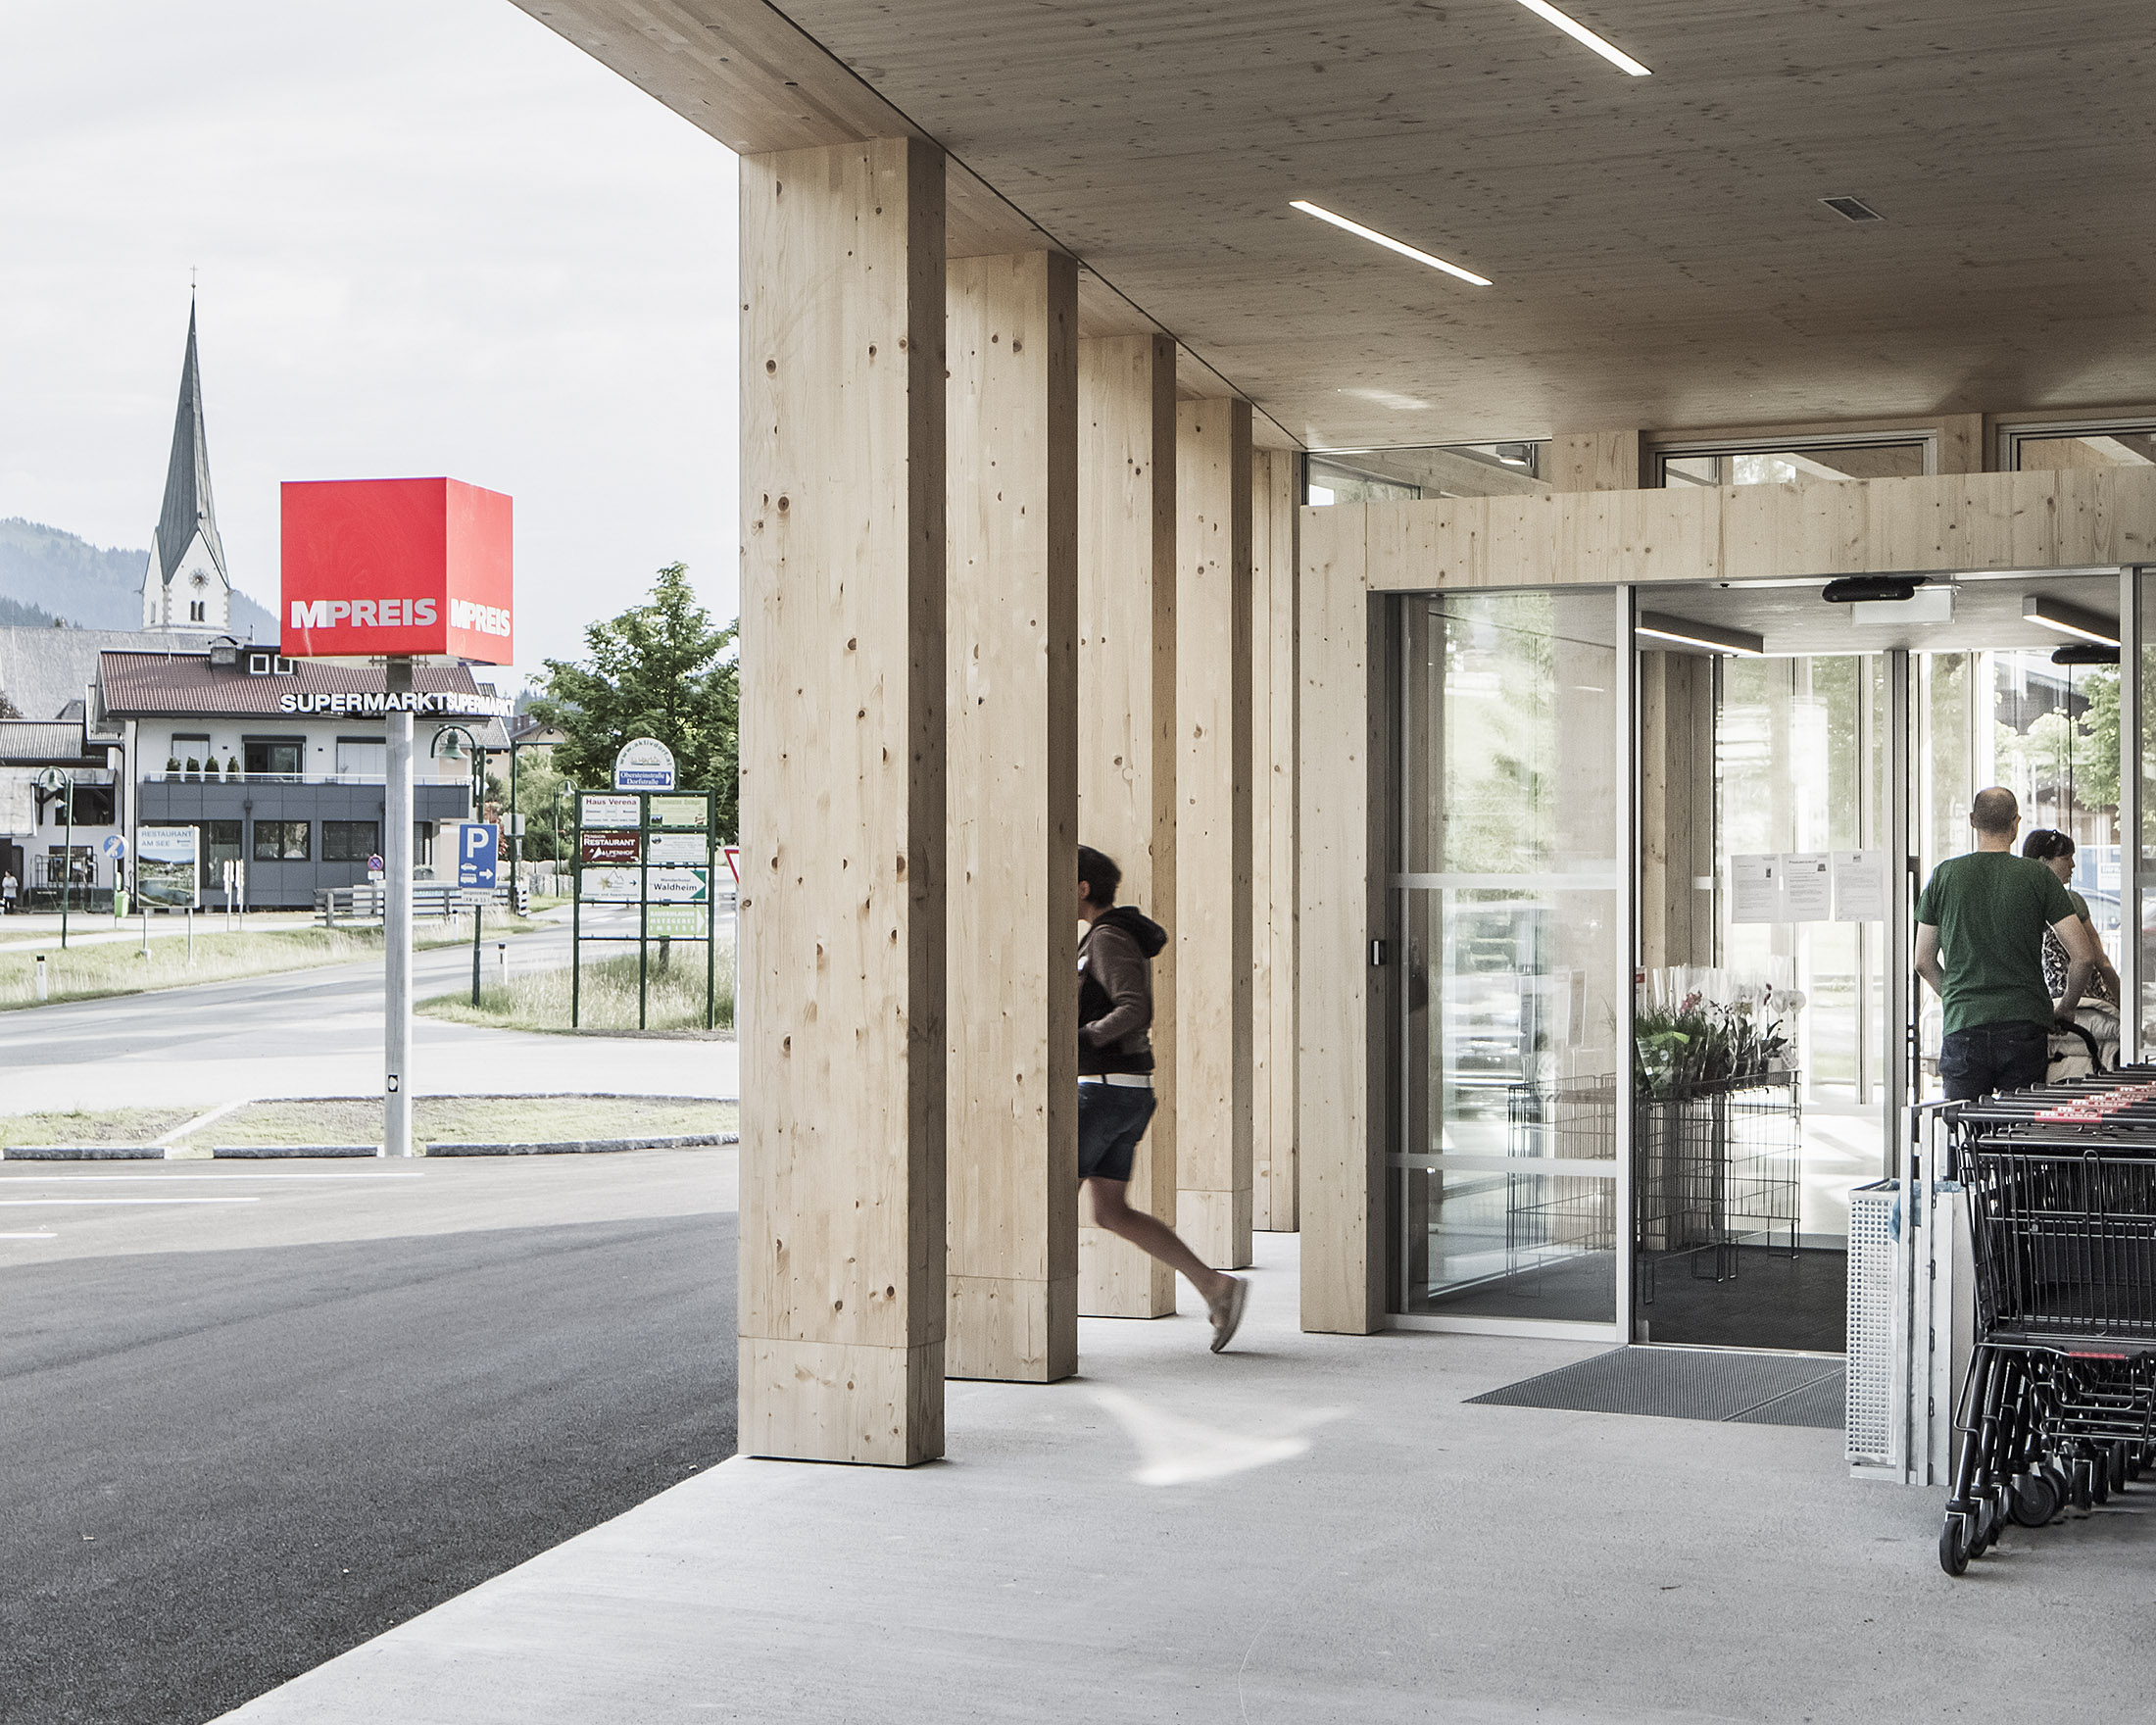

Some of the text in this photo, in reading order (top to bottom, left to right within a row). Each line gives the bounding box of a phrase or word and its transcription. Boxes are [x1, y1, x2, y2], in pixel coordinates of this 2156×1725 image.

[291, 599, 437, 628] MPREIS
[451, 599, 511, 637] MPREIS
[280, 692, 448, 713] SUPERMARKT
[447, 692, 515, 717] SUPERMARKT
[466, 827, 489, 859] P
